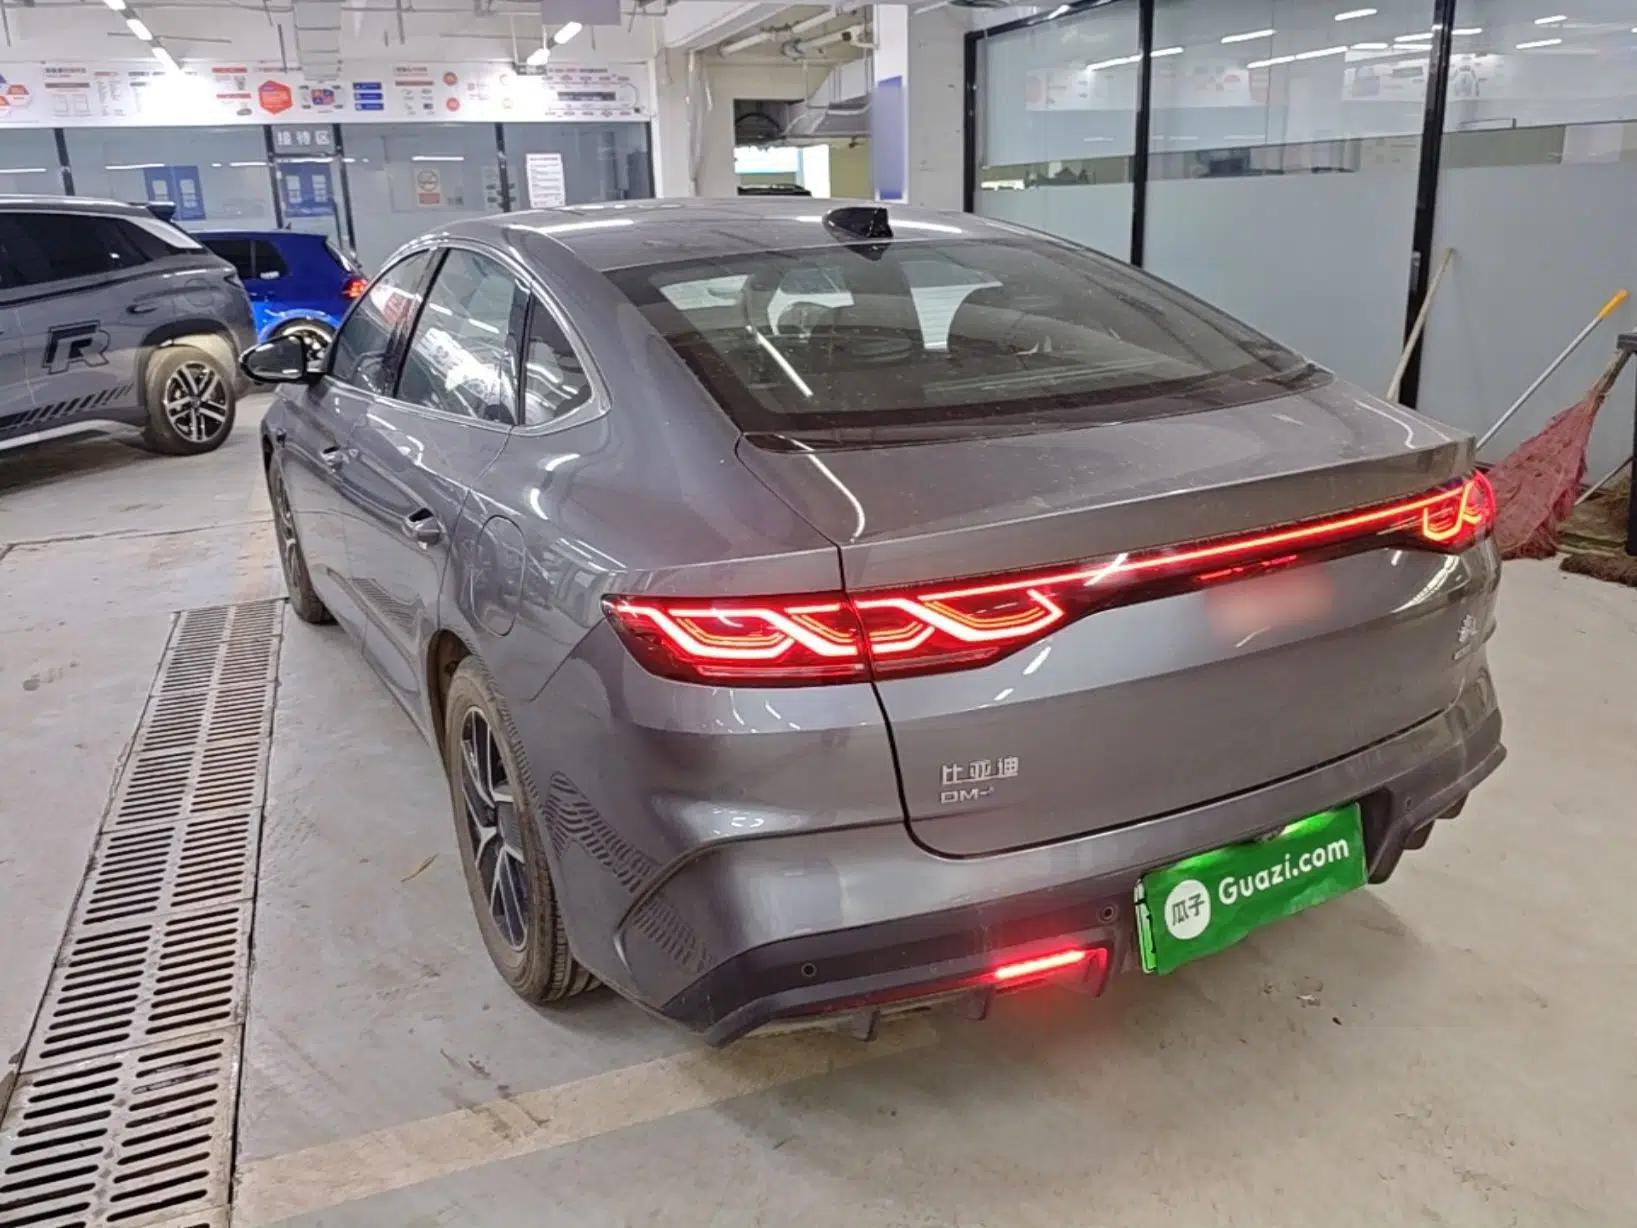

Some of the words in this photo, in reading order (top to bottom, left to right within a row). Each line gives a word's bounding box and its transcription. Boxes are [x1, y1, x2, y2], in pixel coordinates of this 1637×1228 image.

[942, 757, 1019, 785] 比亚迪
[1218, 839, 1349, 905] Guazi.com
[1172, 892, 1205, 926] 瓜子
